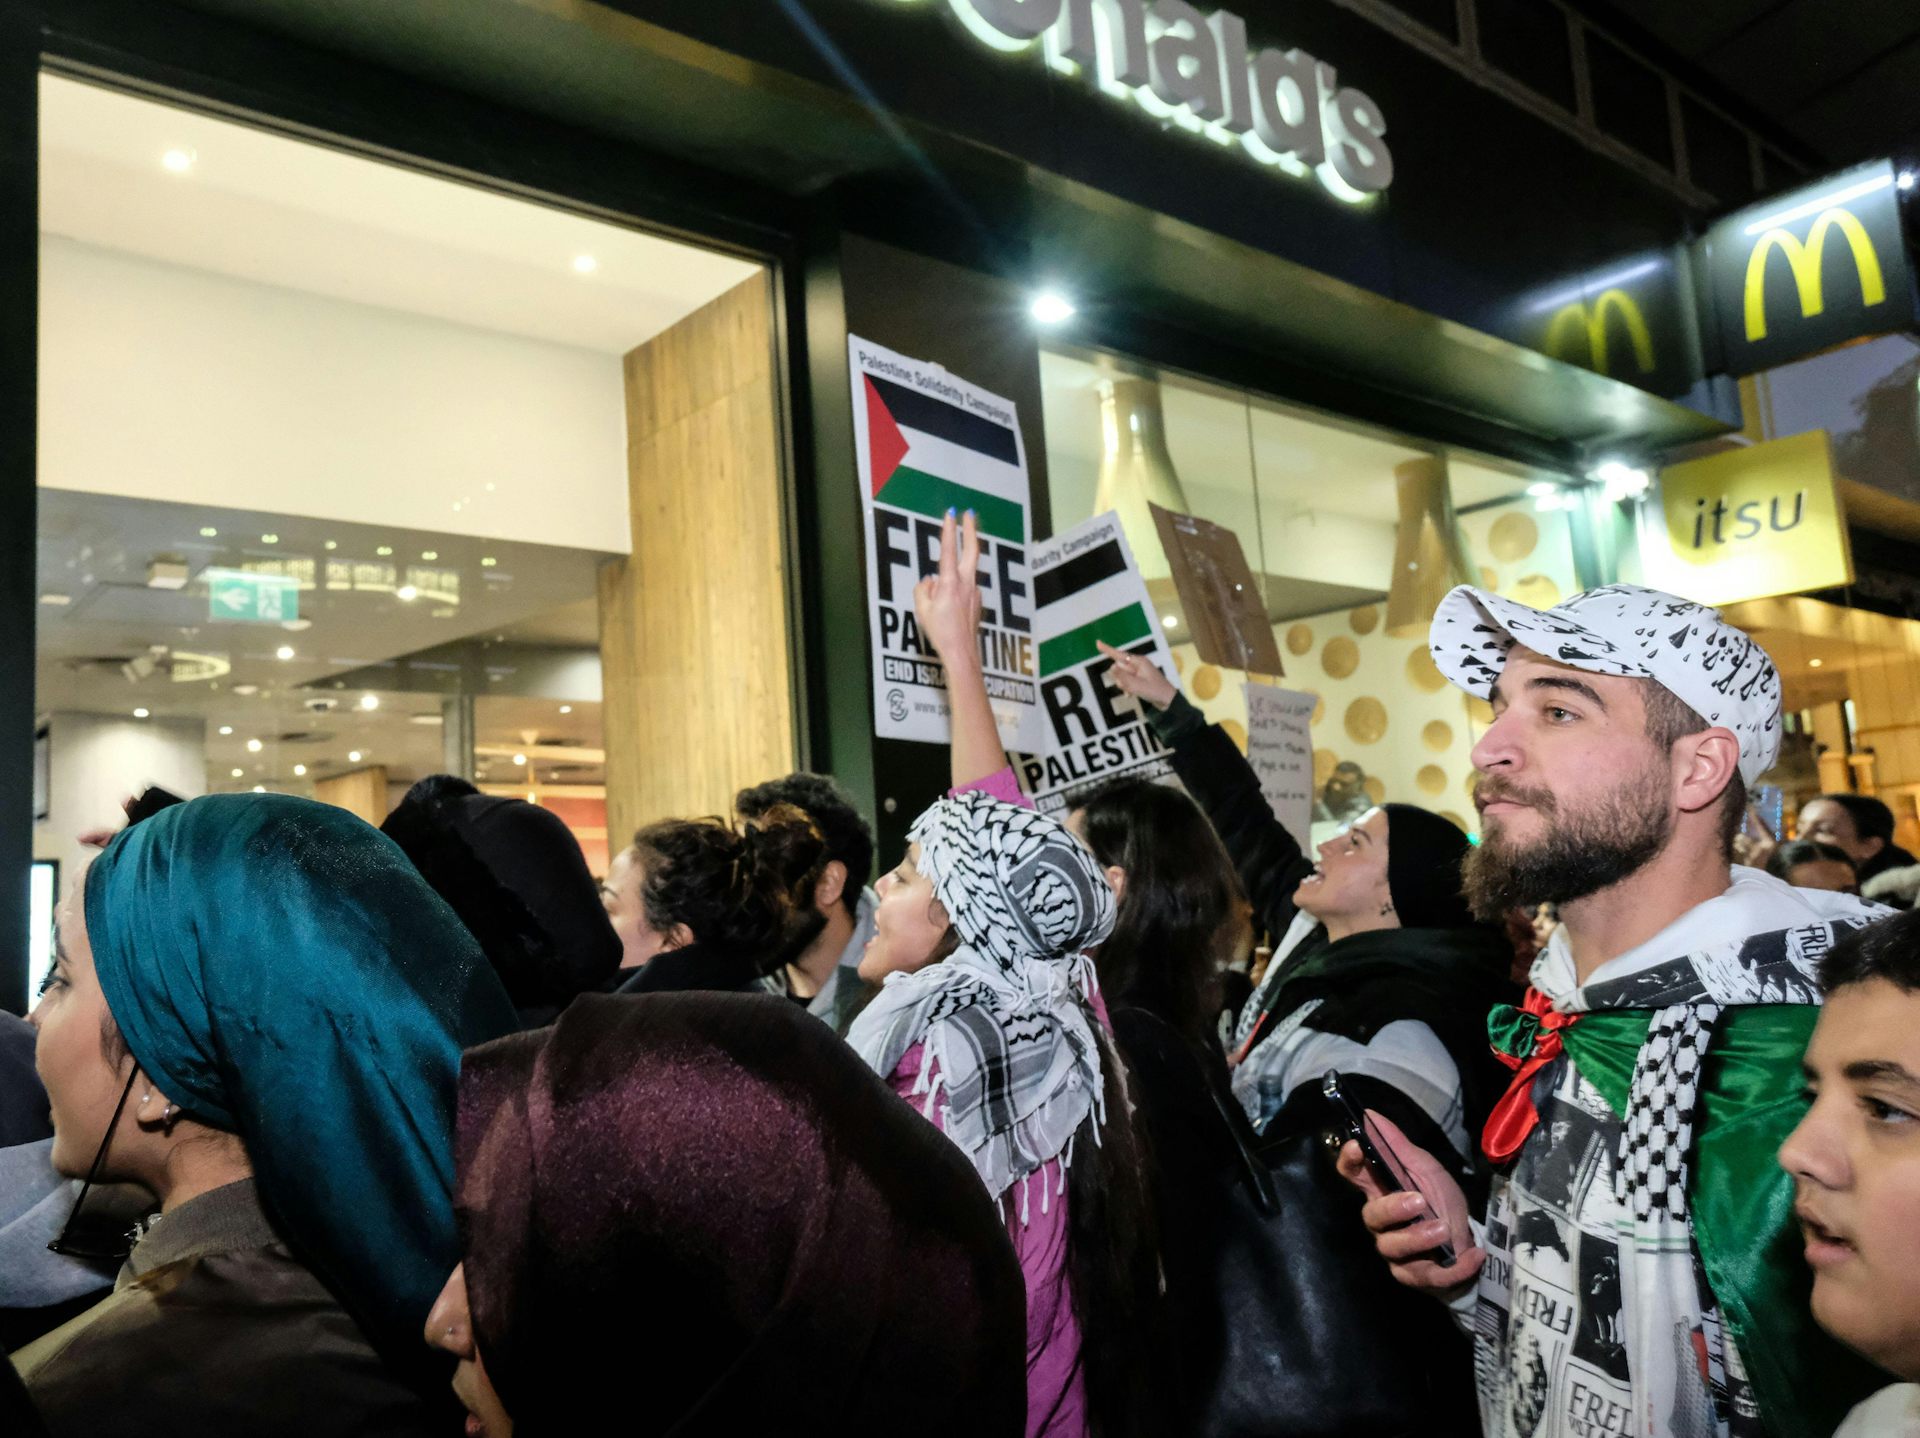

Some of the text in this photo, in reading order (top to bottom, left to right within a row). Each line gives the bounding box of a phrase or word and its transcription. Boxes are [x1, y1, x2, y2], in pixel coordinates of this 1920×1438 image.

[858, 351, 1013, 425] Palestine Solidarity Campaign
[1031, 523, 1114, 570] darity Campaign
[1692, 491, 1803, 549] itsu
[878, 605, 1034, 677] PALTINE
[885, 659, 915, 683] END
[1039, 641, 1166, 748] RE
[1023, 722, 1168, 795] PALESTIN
